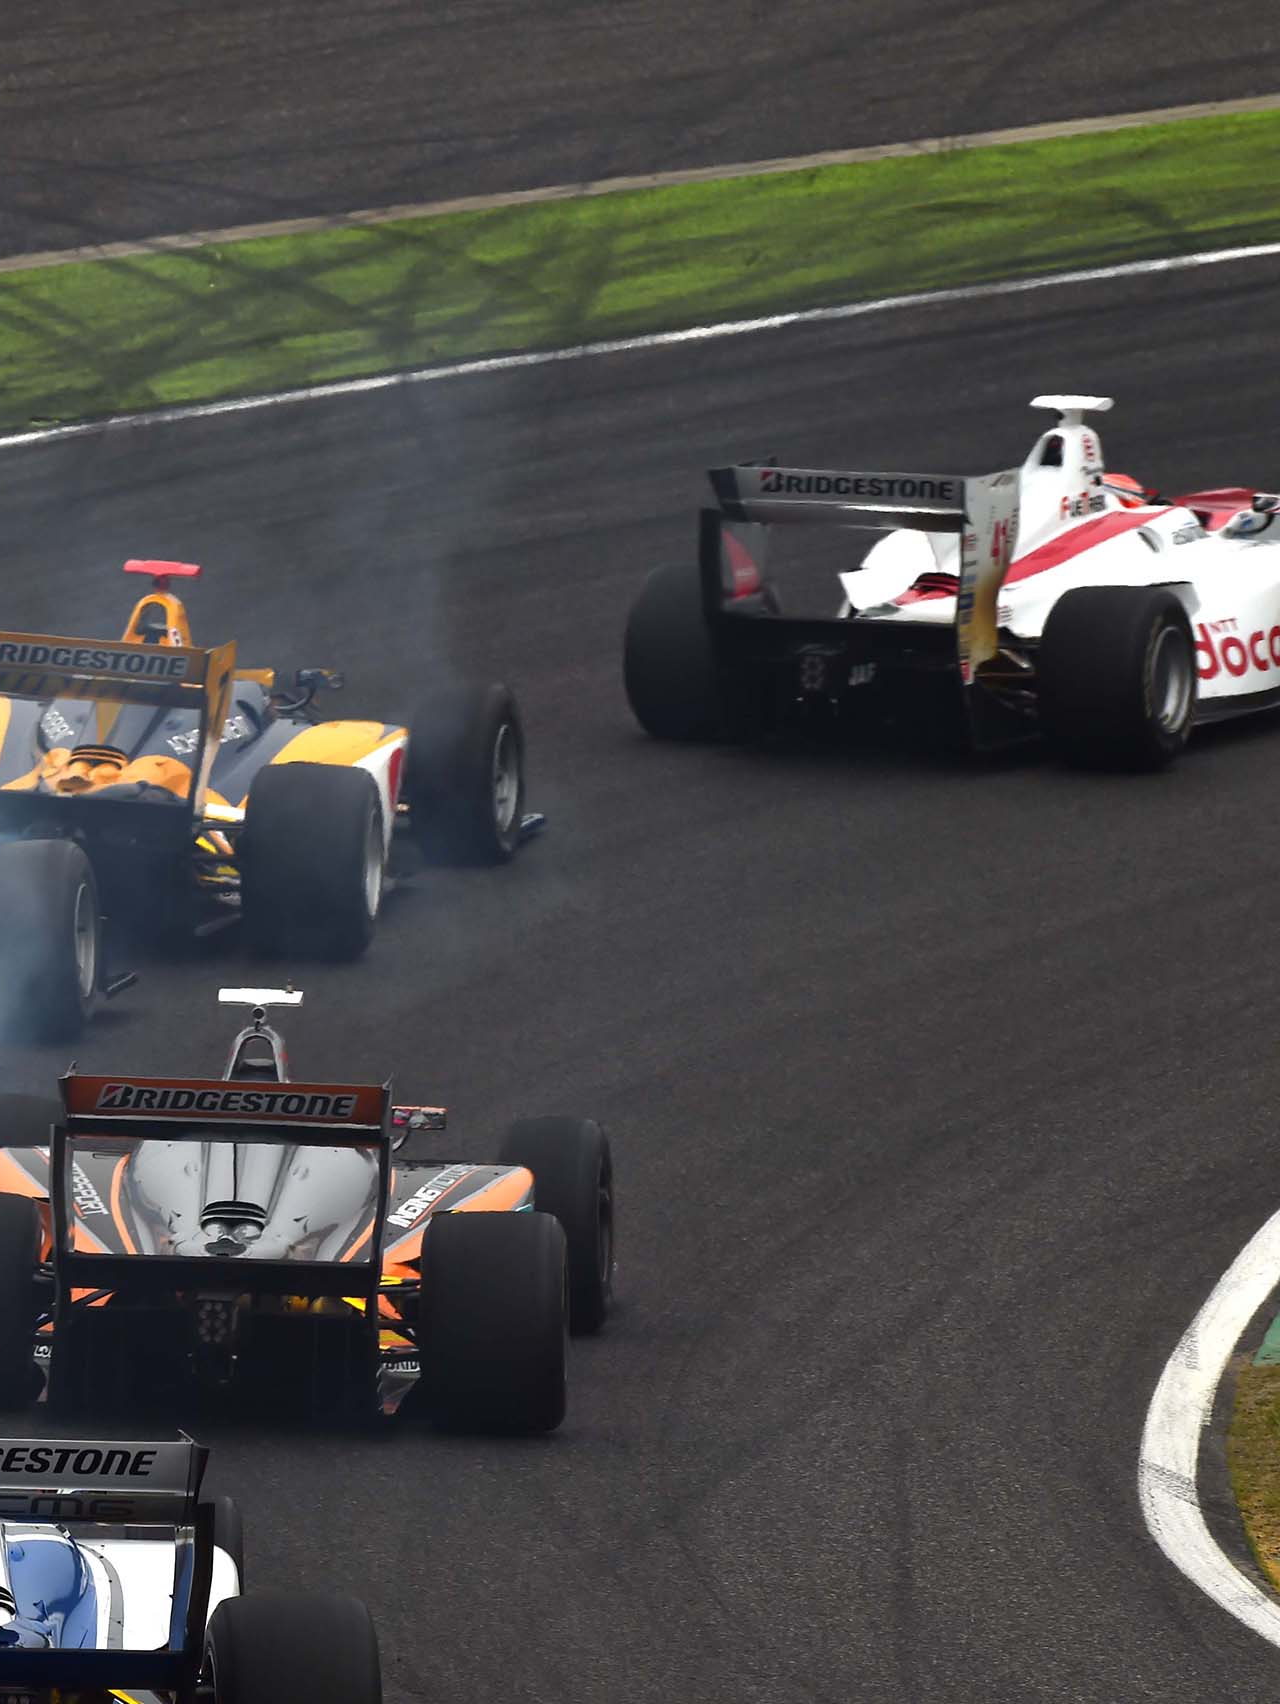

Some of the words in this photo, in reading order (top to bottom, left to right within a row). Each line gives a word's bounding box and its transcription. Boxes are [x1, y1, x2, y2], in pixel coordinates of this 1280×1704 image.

[760, 471, 953, 500] BRIDGESTONE
[1209, 617, 1238, 633] NTT
[100, 1084, 353, 1117] BRIDGESTONE
